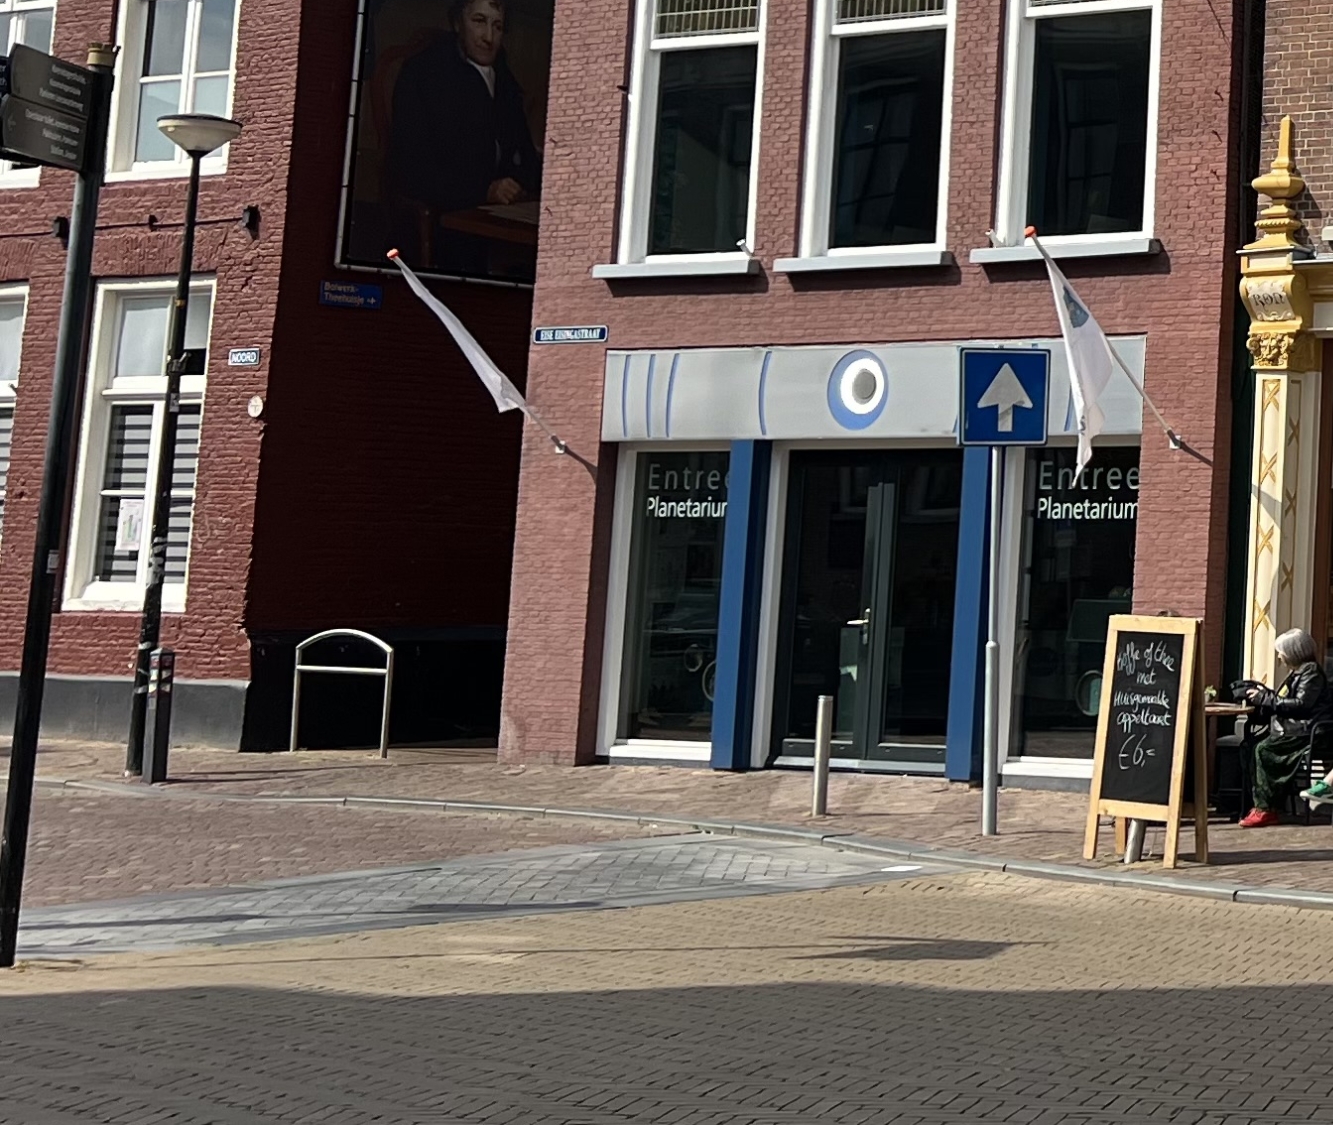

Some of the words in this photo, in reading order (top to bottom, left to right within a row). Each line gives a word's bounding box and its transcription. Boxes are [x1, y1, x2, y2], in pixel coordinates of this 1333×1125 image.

[231, 351, 257, 363] NOORD
[1039, 461, 1140, 490] Entree
[1037, 496, 1139, 520] Planetarium
[1144, 642, 1154, 668] of
[1136, 668, 1156, 685] met
